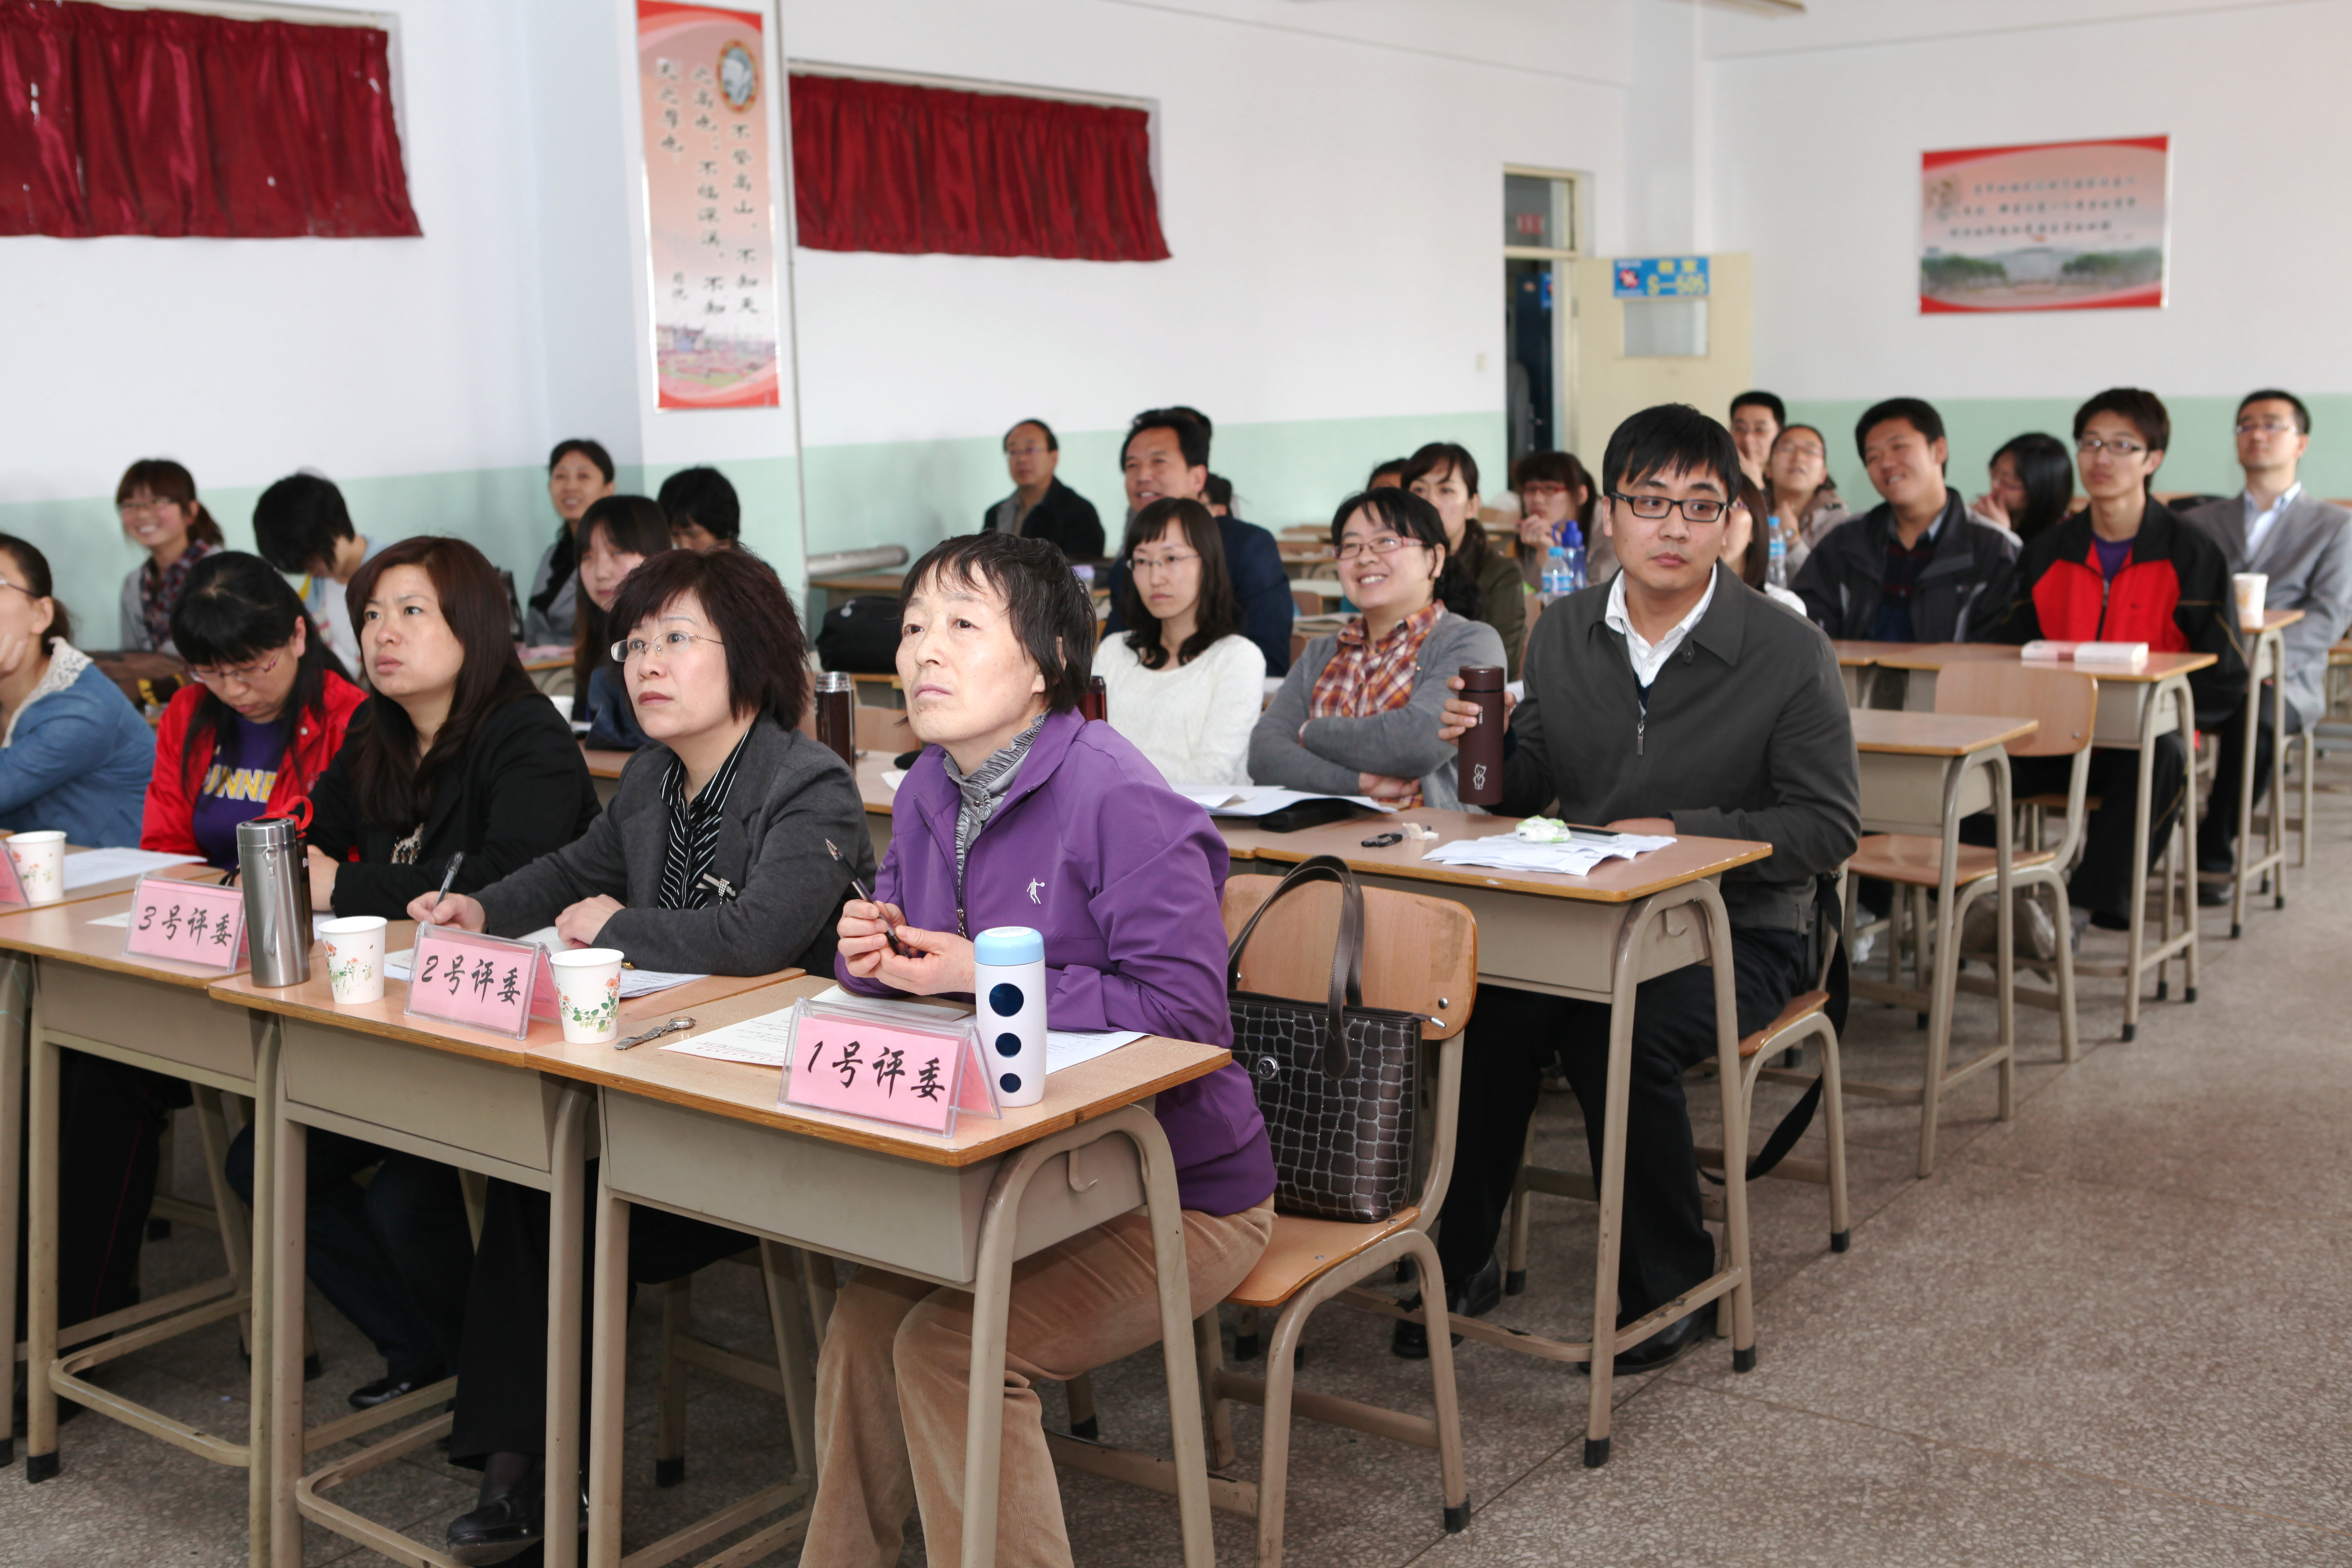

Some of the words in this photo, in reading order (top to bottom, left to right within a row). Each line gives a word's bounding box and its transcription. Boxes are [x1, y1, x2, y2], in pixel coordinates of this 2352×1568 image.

[138, 905, 232, 947] 3号评委
[421, 954, 521, 1006] 2号评委
[807, 1040, 945, 1102] 1号评委
